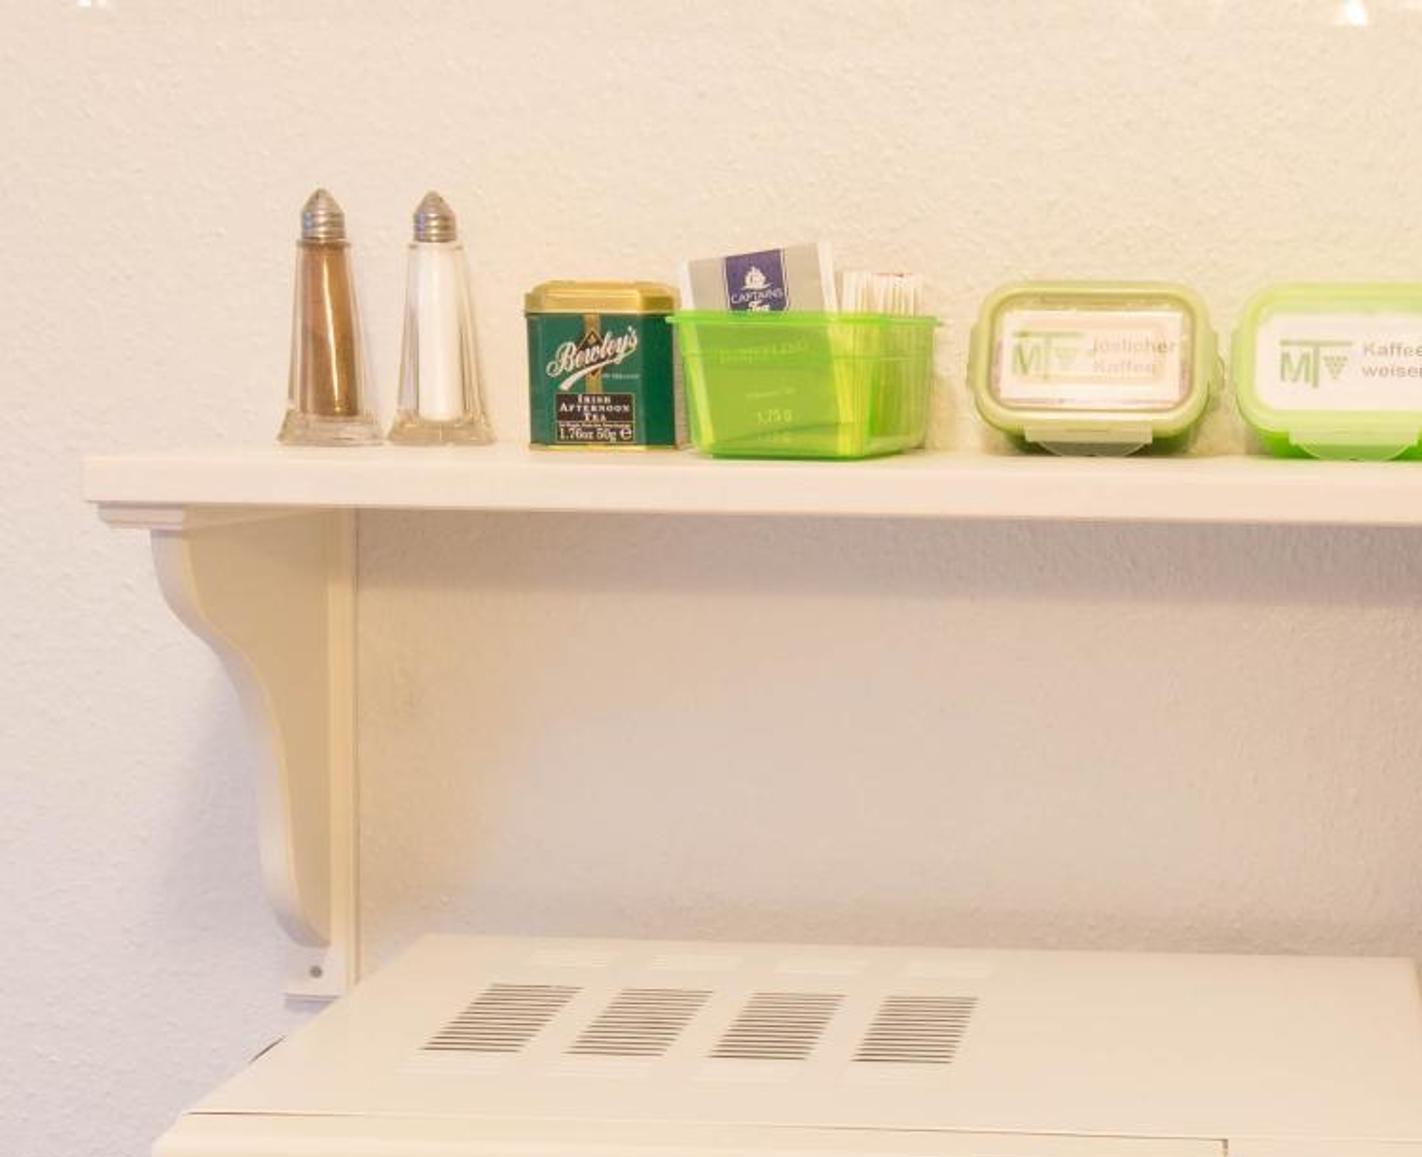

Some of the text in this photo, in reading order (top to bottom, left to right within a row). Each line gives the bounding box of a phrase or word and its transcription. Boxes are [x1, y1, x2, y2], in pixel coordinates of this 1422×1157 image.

[546, 326, 638, 385] Bewley's
[559, 403, 630, 413] AFTERNOON
[583, 413, 608, 421] TEA
